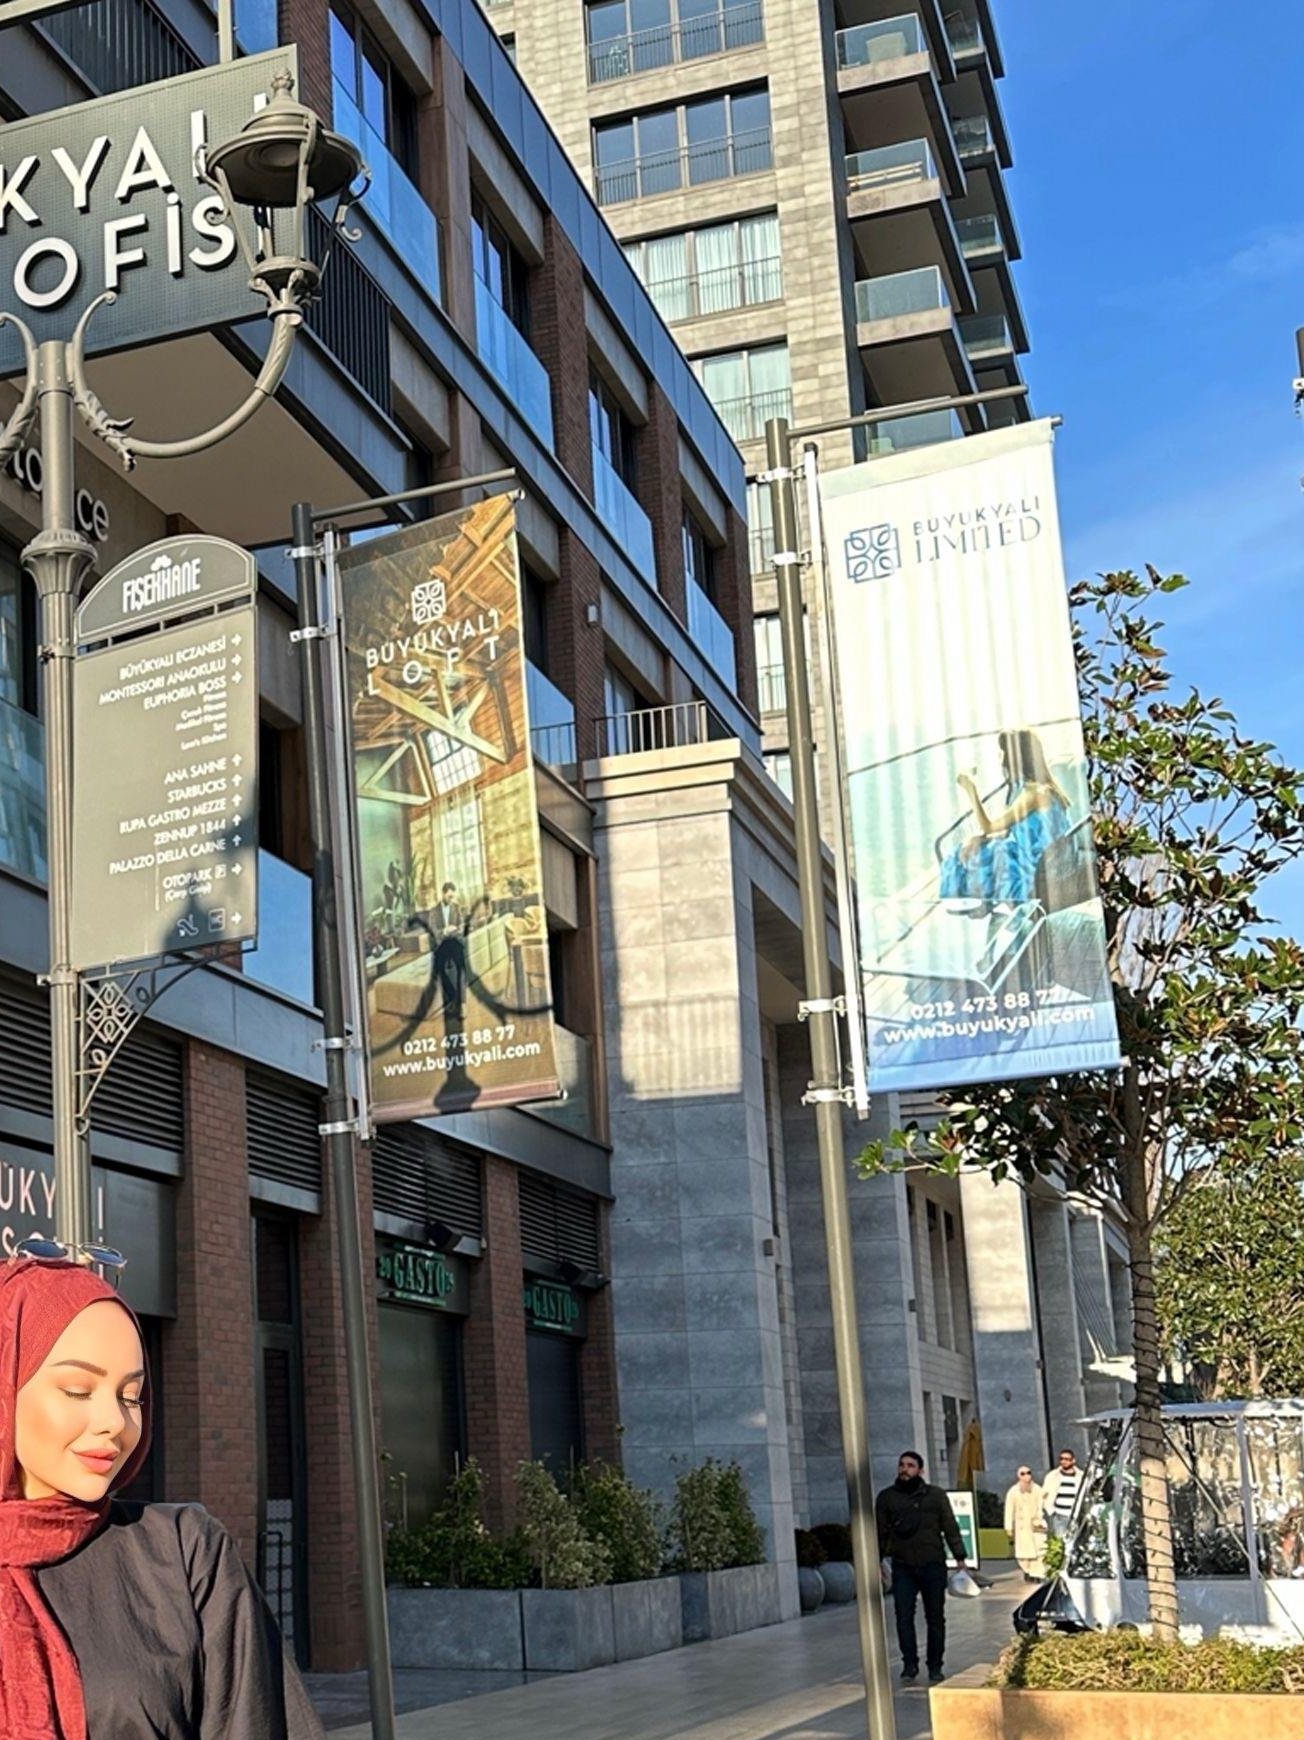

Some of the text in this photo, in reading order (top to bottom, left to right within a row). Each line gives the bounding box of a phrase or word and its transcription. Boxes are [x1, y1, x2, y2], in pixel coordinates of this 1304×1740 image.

[915, 515, 1042, 564] LIMITED
[167, 658, 227, 686] ANAOKULU
[144, 686, 196, 710] EUPHORIA
[198, 676, 227, 694] BOSS
[164, 757, 227, 785] ANA SAHNE
[167, 778, 227, 803] STARBUCKS
[147, 807, 190, 827] GASTRO
[192, 798, 227, 817] MEZZE
[200, 819, 227, 835] 1844
[109, 839, 227, 875] PALAZZO DELLA CARNE
[162, 868, 213, 889] OTOPARK
[910, 1001, 956, 1021] 0212
[962, 995, 998, 1014] 473
[1004, 991, 1031, 1010] 88
[403, 1024, 515, 1056] 0212 473 88 77
[383, 1042, 540, 1076] www.buyukyali.com
[394, 1251, 446, 1298] GASTO
